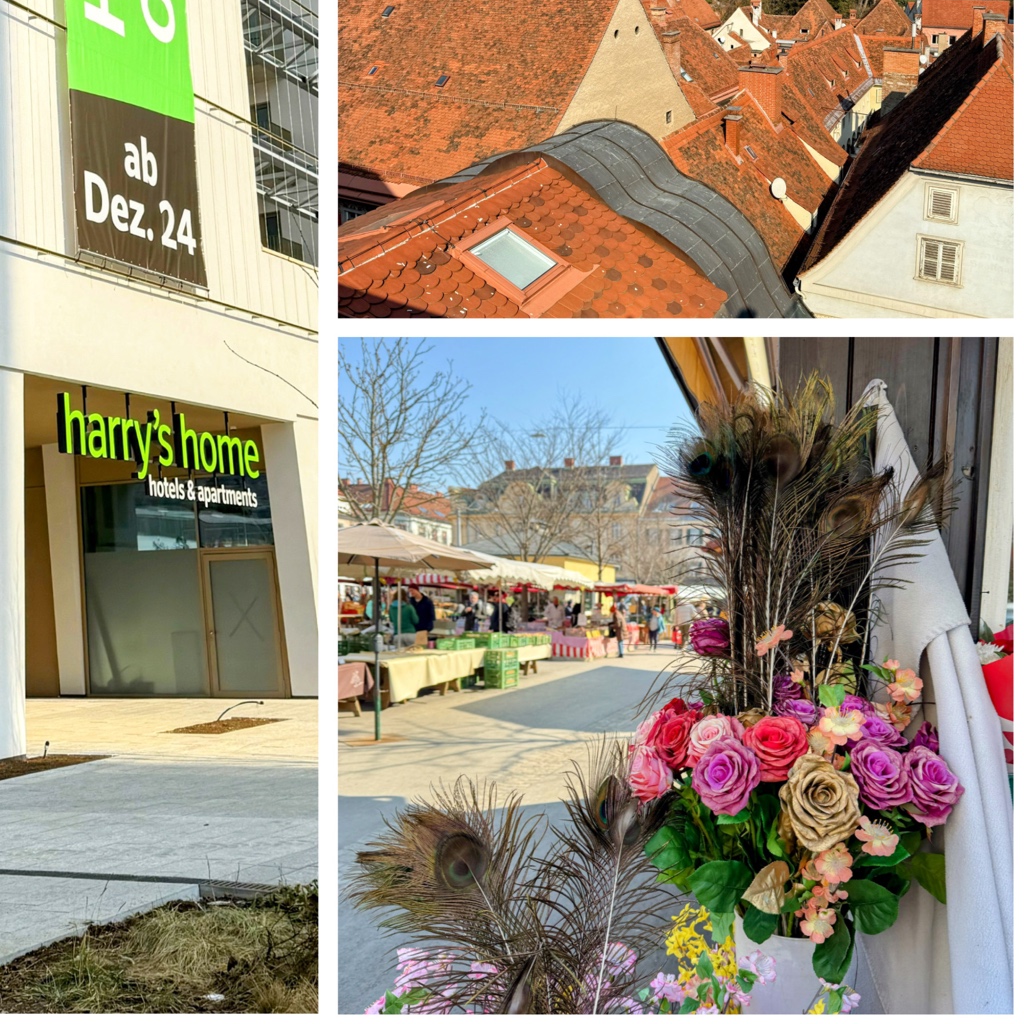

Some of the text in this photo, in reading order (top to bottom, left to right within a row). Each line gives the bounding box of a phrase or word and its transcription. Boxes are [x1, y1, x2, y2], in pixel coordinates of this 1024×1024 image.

[124, 135, 158, 187] ab
[83, 170, 197, 256] Dez. 24
[62, 392, 260, 480] harry's home
[148, 474, 258, 508] hotels & apartments
